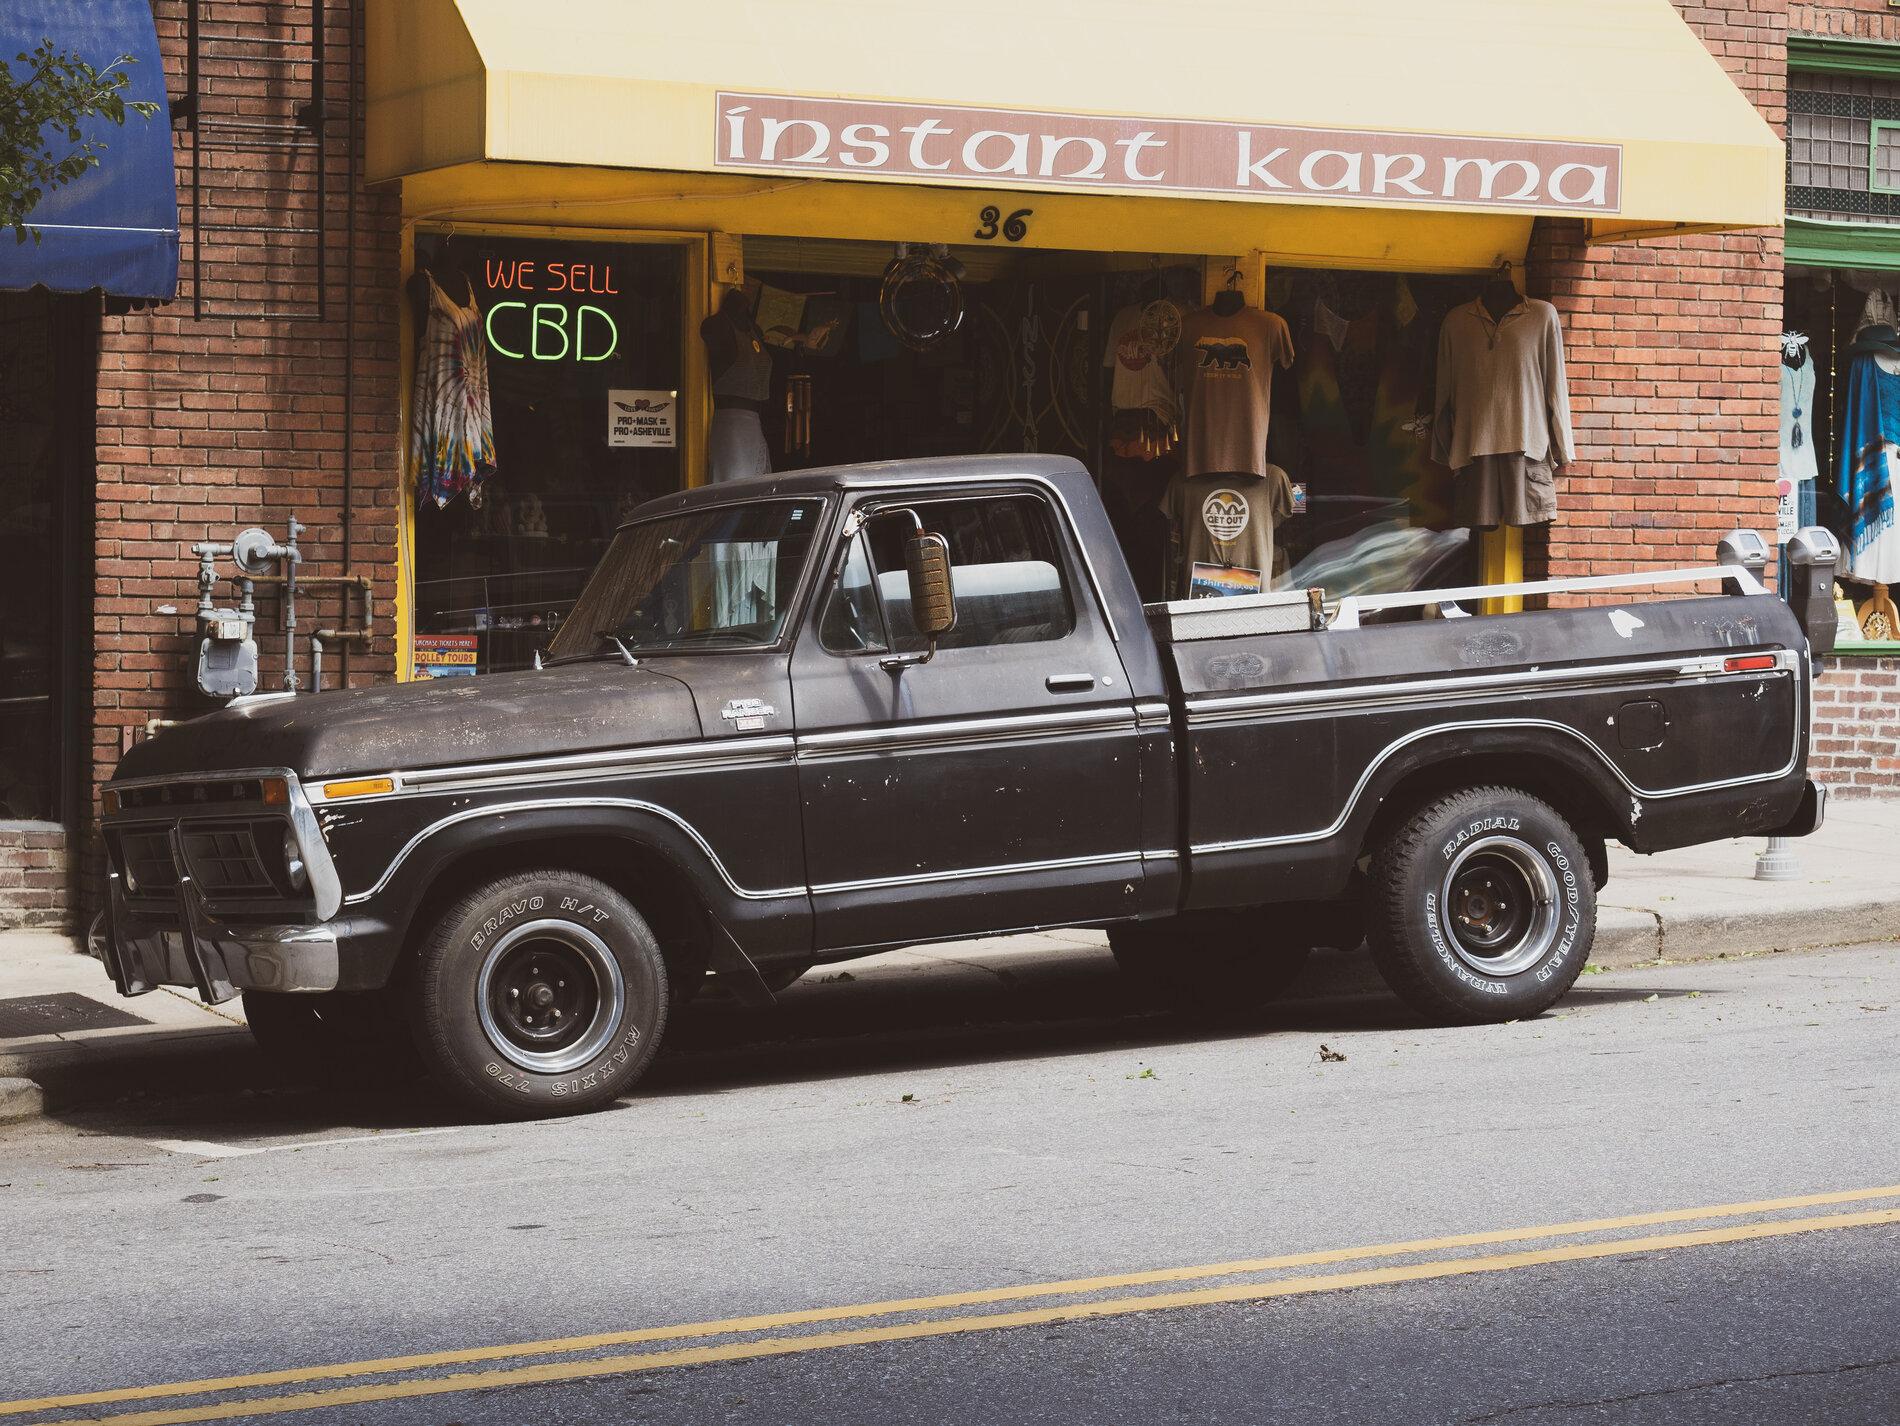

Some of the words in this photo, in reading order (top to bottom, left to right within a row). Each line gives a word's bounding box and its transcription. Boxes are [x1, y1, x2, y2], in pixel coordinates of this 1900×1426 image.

[974, 205, 1034, 242] 36
[486, 259, 535, 290] WE
[547, 263, 618, 294] SELL
[485, 301, 618, 362] CBD
[1207, 515, 1225, 524] GET
[1226, 516, 1244, 525] OUT
[447, 653, 474, 663] TOURS
[1441, 817, 1520, 860] RADIAL
[470, 896, 544, 951] BRAVO
[560, 896, 610, 923] H/T
[1426, 893, 1508, 994] WRANGLER
[485, 1062, 531, 1094] 770
[551, 1025, 641, 1097] MAXXIS
